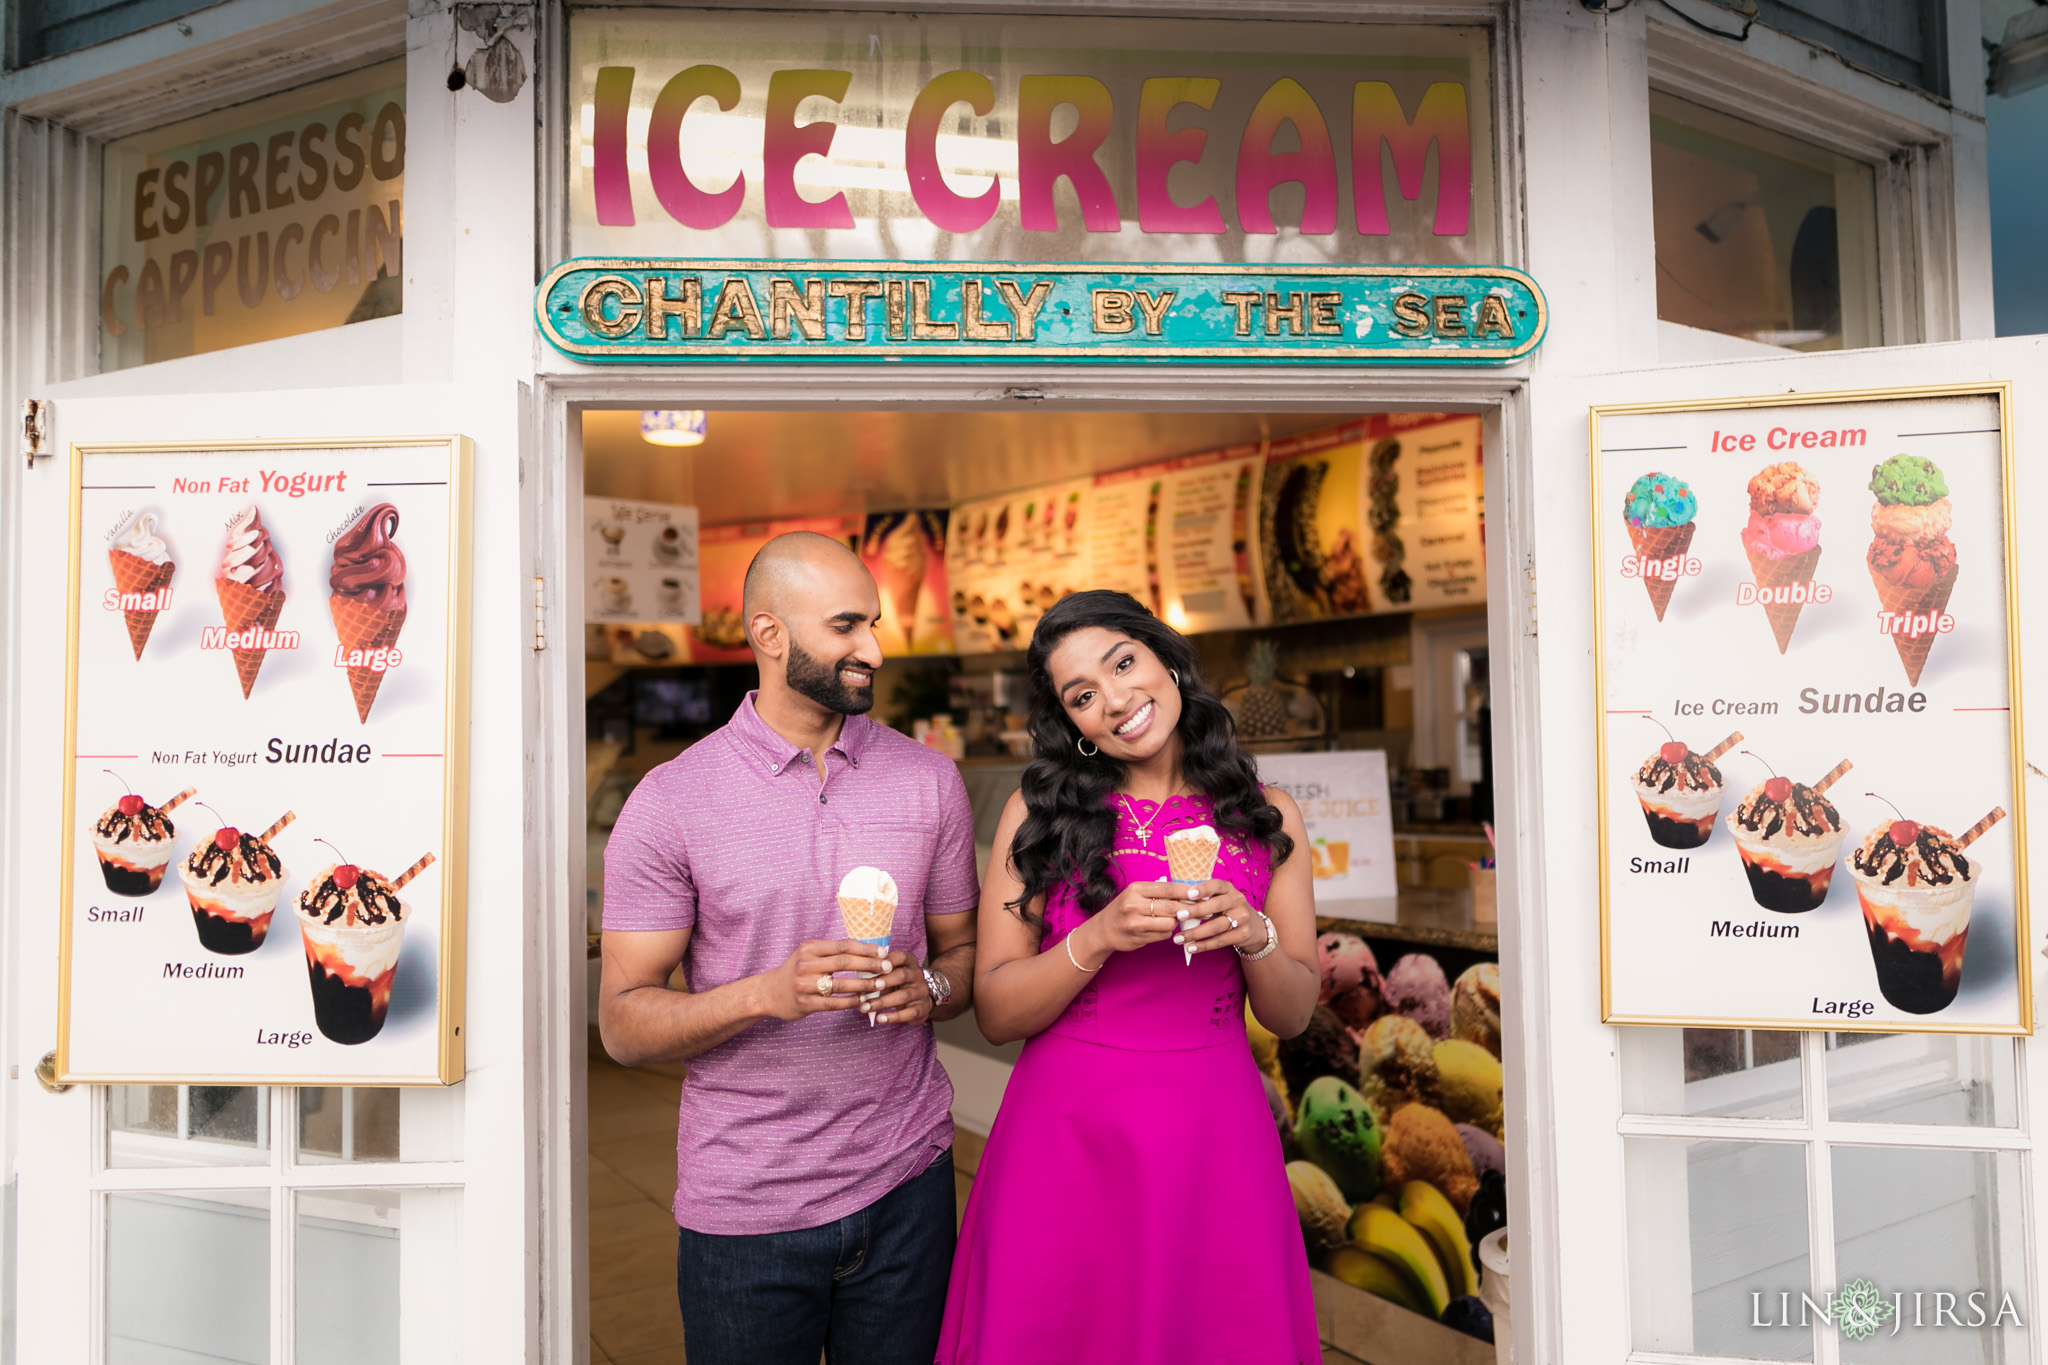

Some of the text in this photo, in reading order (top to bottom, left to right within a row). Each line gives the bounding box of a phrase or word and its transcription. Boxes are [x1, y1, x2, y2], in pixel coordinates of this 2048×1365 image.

[594, 64, 1471, 237] ICE CREAM
[134, 101, 406, 242] ESPRESSO
[581, 275, 1515, 341] CHANTILLY BY THE SEA
[1711, 426, 1867, 453] Ice Cream
[172, 470, 348, 498] Non Fat Yogurt
[103, 508, 135, 542] Vanilla
[224, 511, 244, 532] Mix
[326, 504, 366, 545] Chocolate
[1620, 554, 1702, 581] Single
[103, 588, 173, 611] Small
[1737, 581, 1832, 605] Double
[1877, 609, 1955, 638] Triple
[201, 626, 299, 650] Medium
[334, 645, 402, 672] Large
[1674, 687, 1927, 716] Ice Cream Sundae
[151, 737, 372, 768] Non Fat Yogurt Sundae
[1629, 856, 1690, 874] Small
[87, 905, 145, 923] Small
[1710, 920, 1800, 939] Medium
[162, 962, 245, 979] Medium
[1811, 997, 1875, 1018] Large
[256, 1028, 313, 1048] Large
